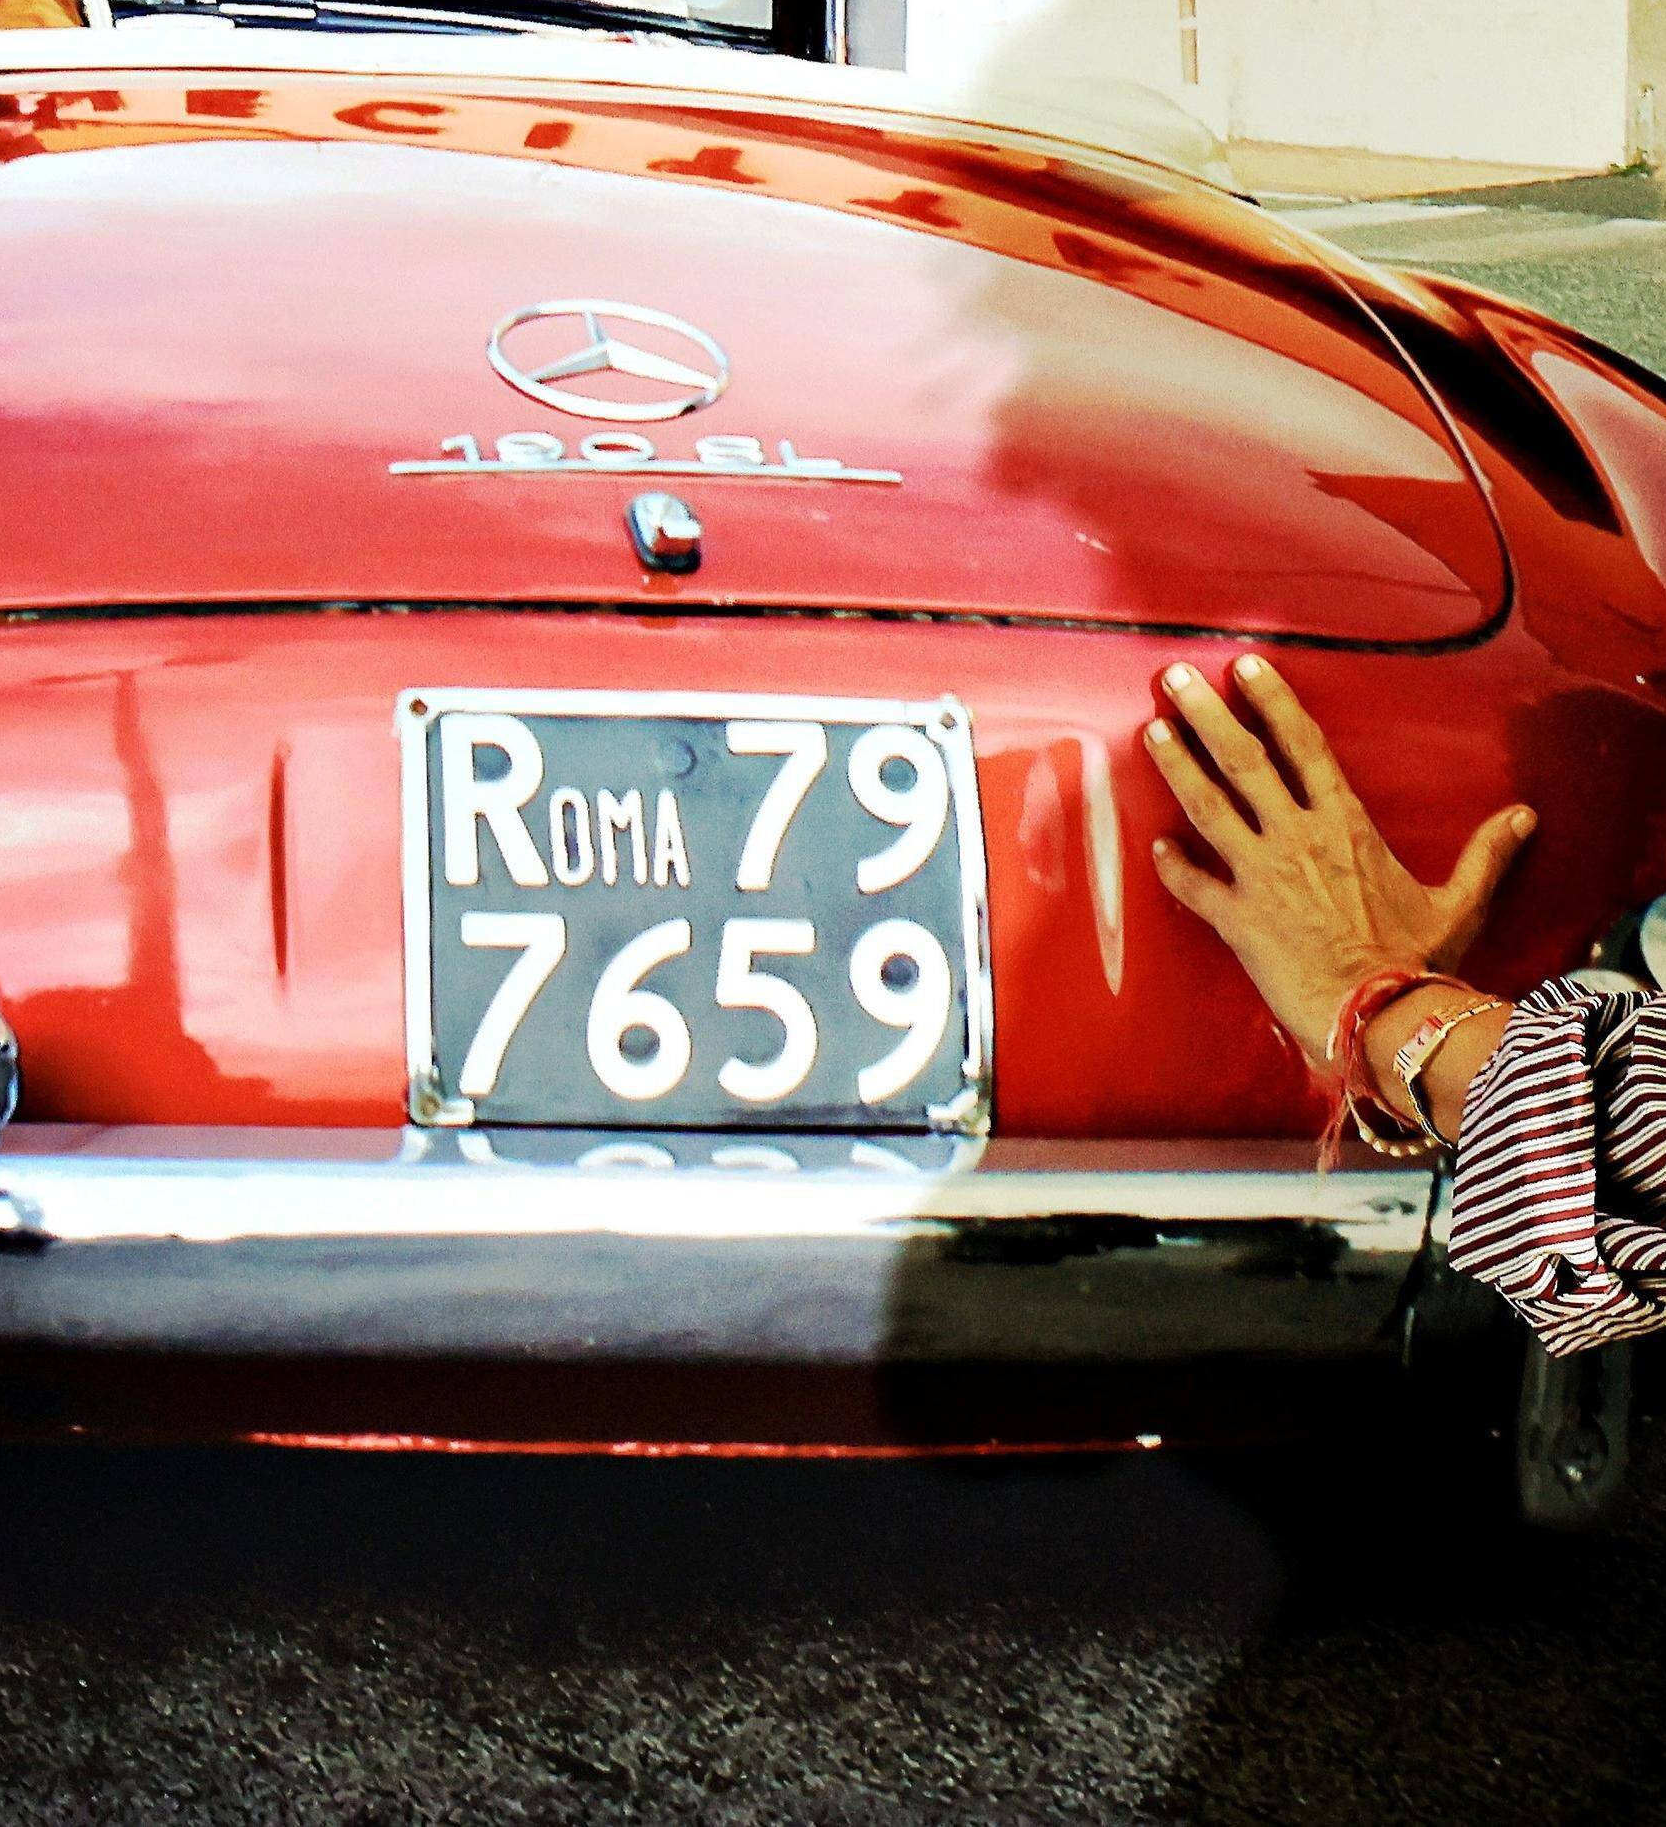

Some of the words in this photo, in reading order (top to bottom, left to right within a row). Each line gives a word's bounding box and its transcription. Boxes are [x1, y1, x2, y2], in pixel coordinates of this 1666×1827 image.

[695, 435, 844, 469] SL
[724, 721, 950, 895] 79
[458, 911, 953, 1104] 7659
